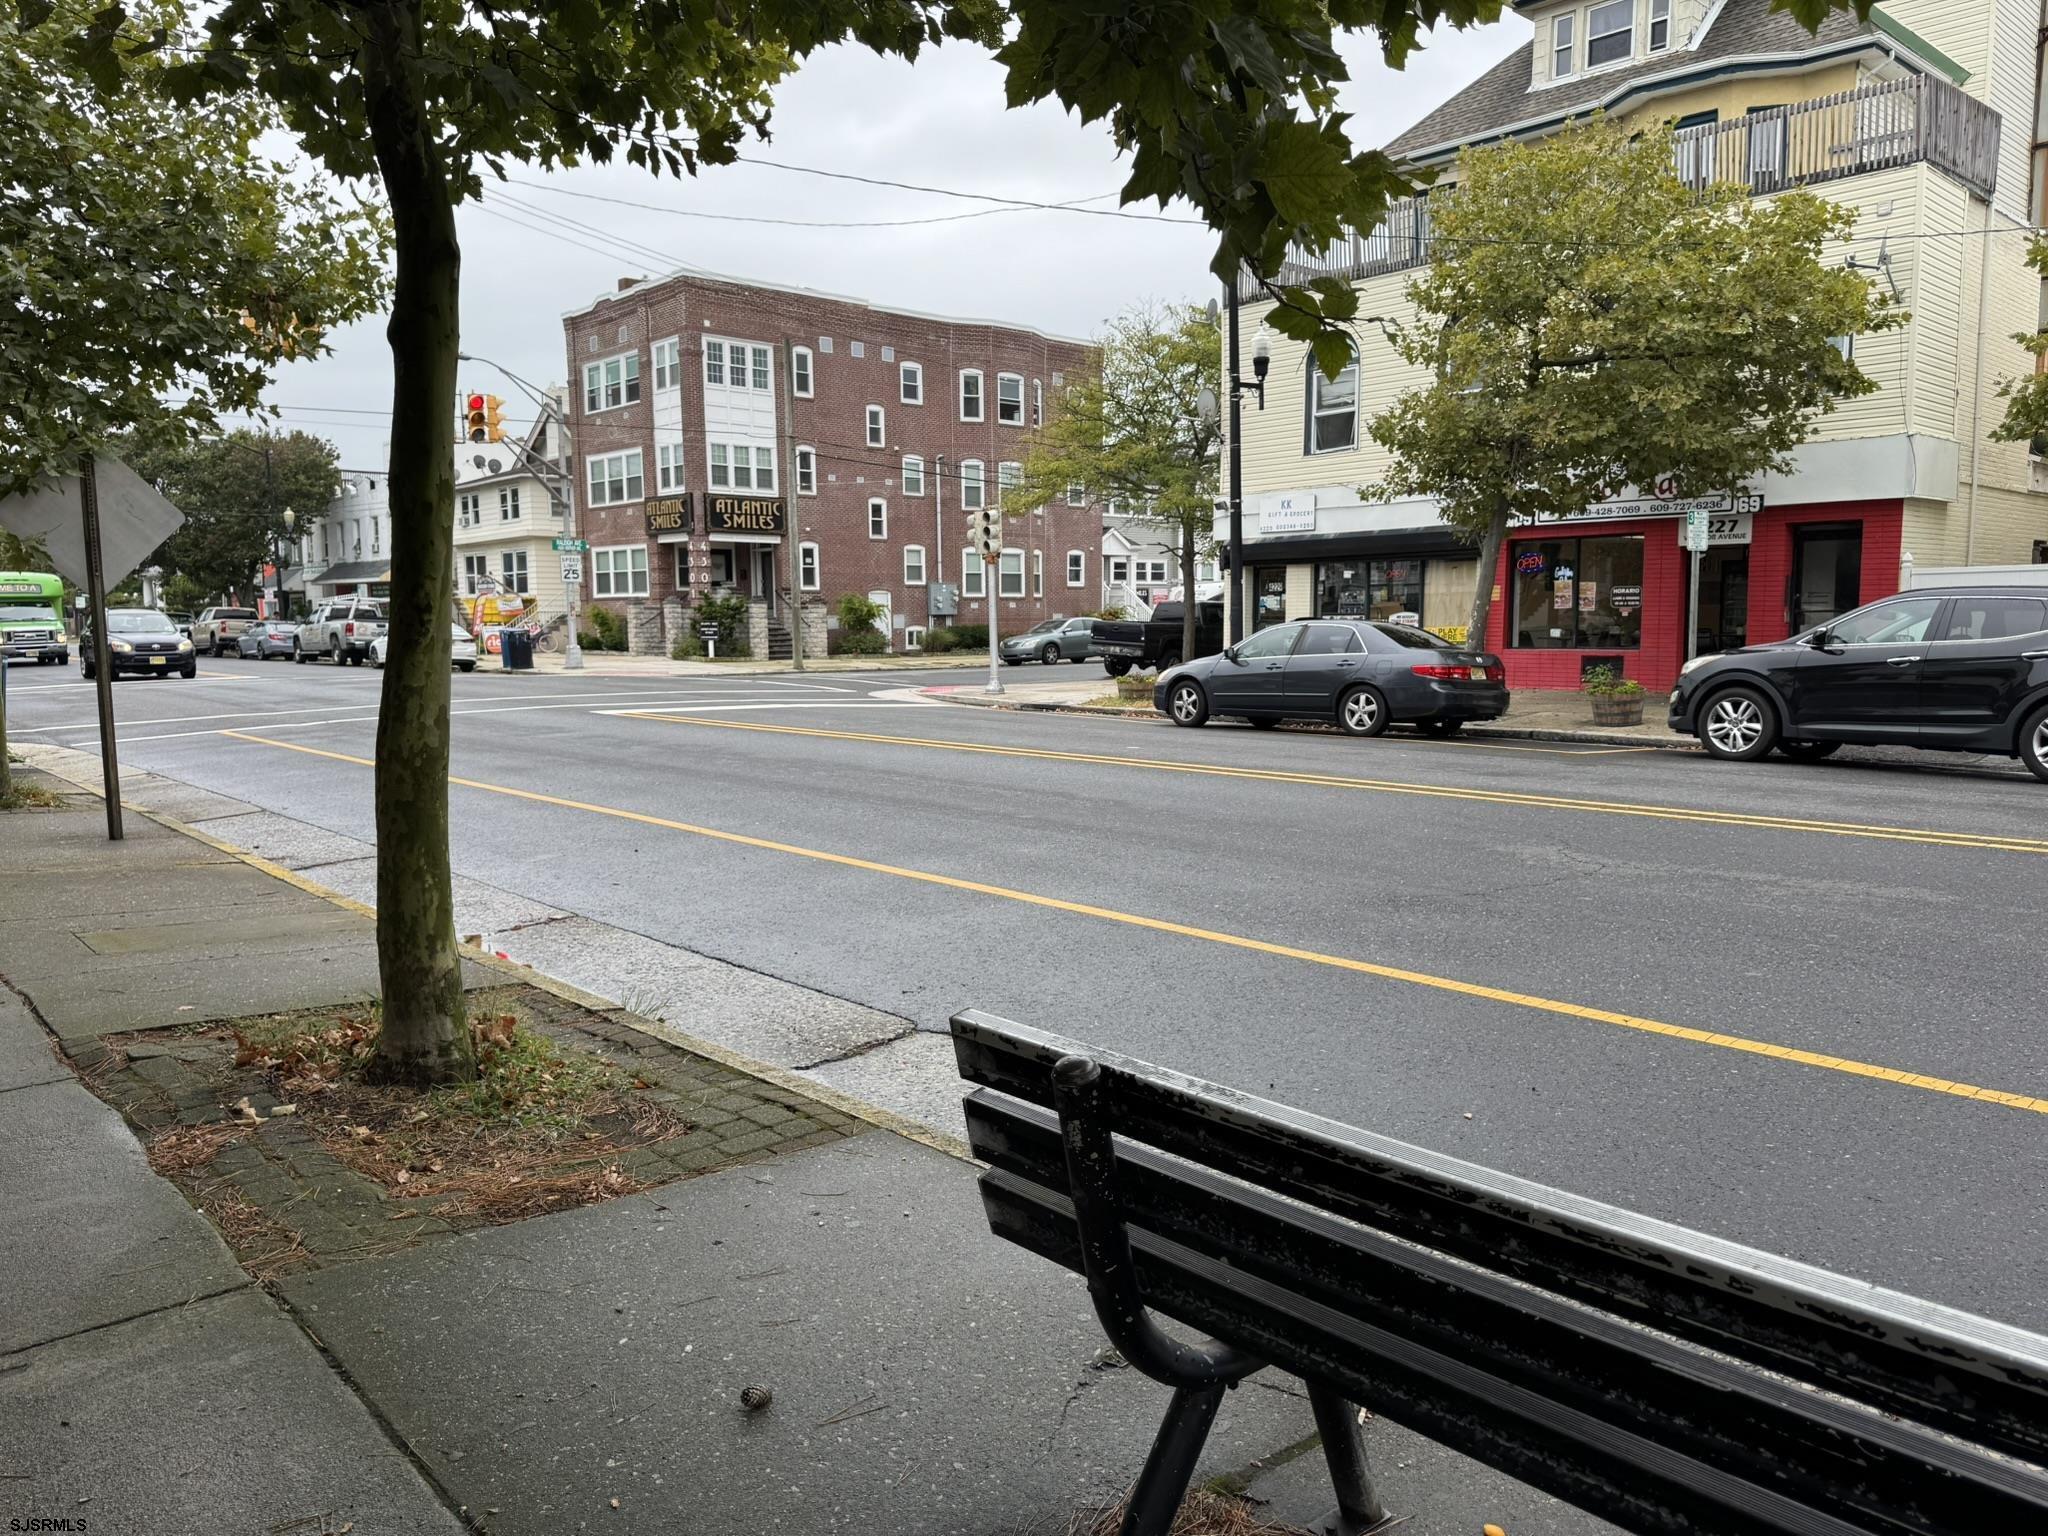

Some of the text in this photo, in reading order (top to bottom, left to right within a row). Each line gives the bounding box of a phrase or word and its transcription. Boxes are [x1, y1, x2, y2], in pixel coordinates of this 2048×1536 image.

[646, 499, 685, 516] ATLANTIC
[716, 499, 780, 516] ATLANTIC
[1281, 500, 1292, 509] KK
[1650, 501, 1723, 512] 609-727-6236
[1738, 496, 1760, 513] 69
[651, 513, 682, 529] SMILES
[723, 514, 775, 529] SMILES
[1517, 555, 1543, 570] OPEN
[564, 569, 580, 580] 25
